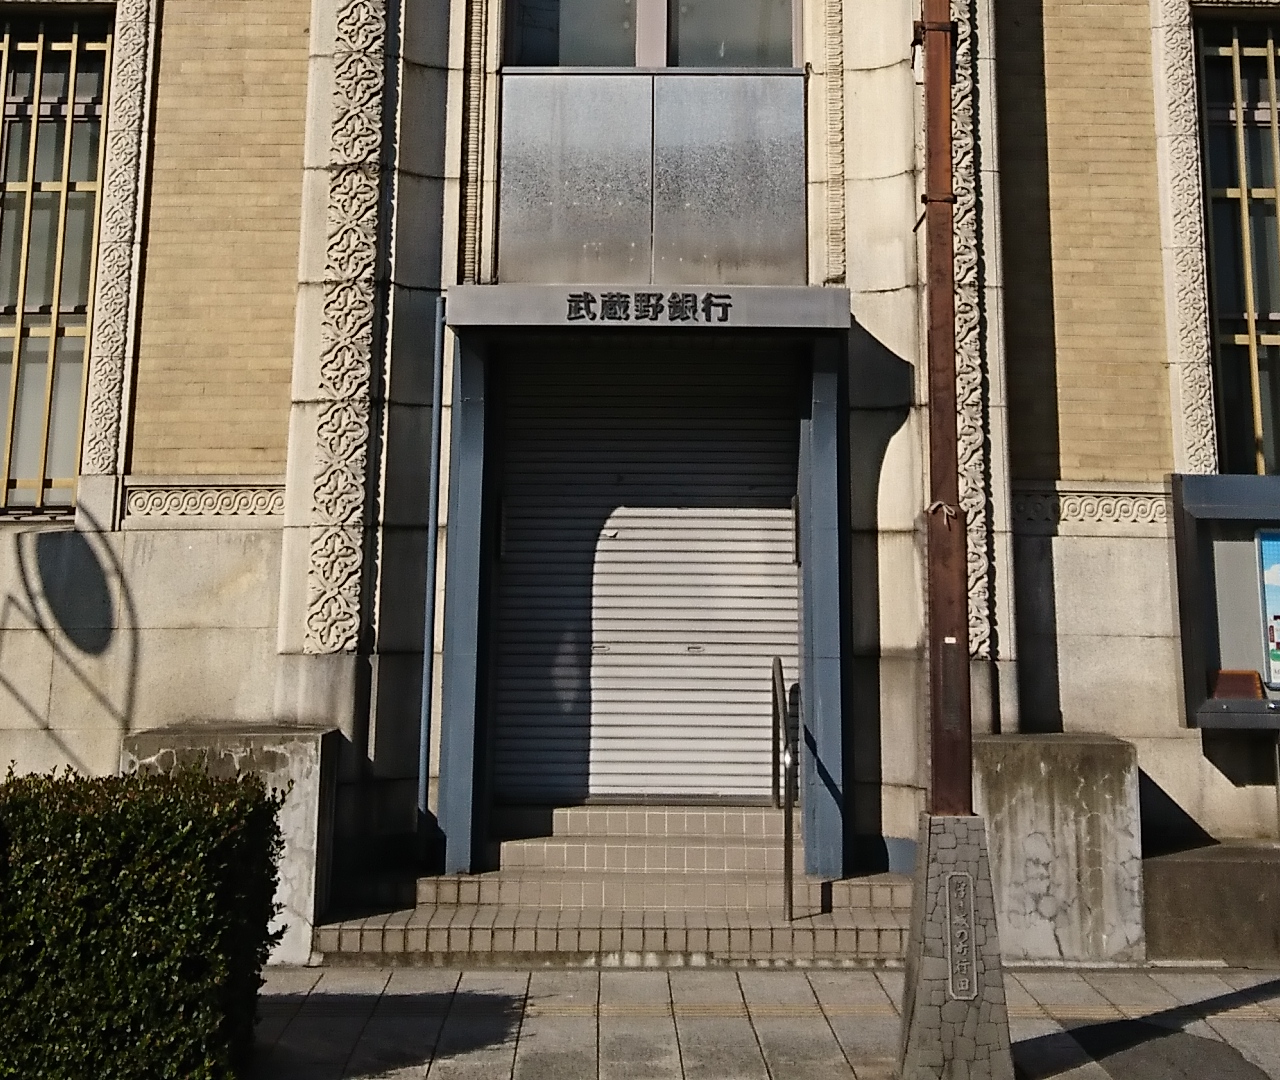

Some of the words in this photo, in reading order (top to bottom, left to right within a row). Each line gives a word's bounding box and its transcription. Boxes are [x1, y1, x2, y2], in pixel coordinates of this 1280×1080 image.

[566, 291, 733, 323] 武蔵野銀行
